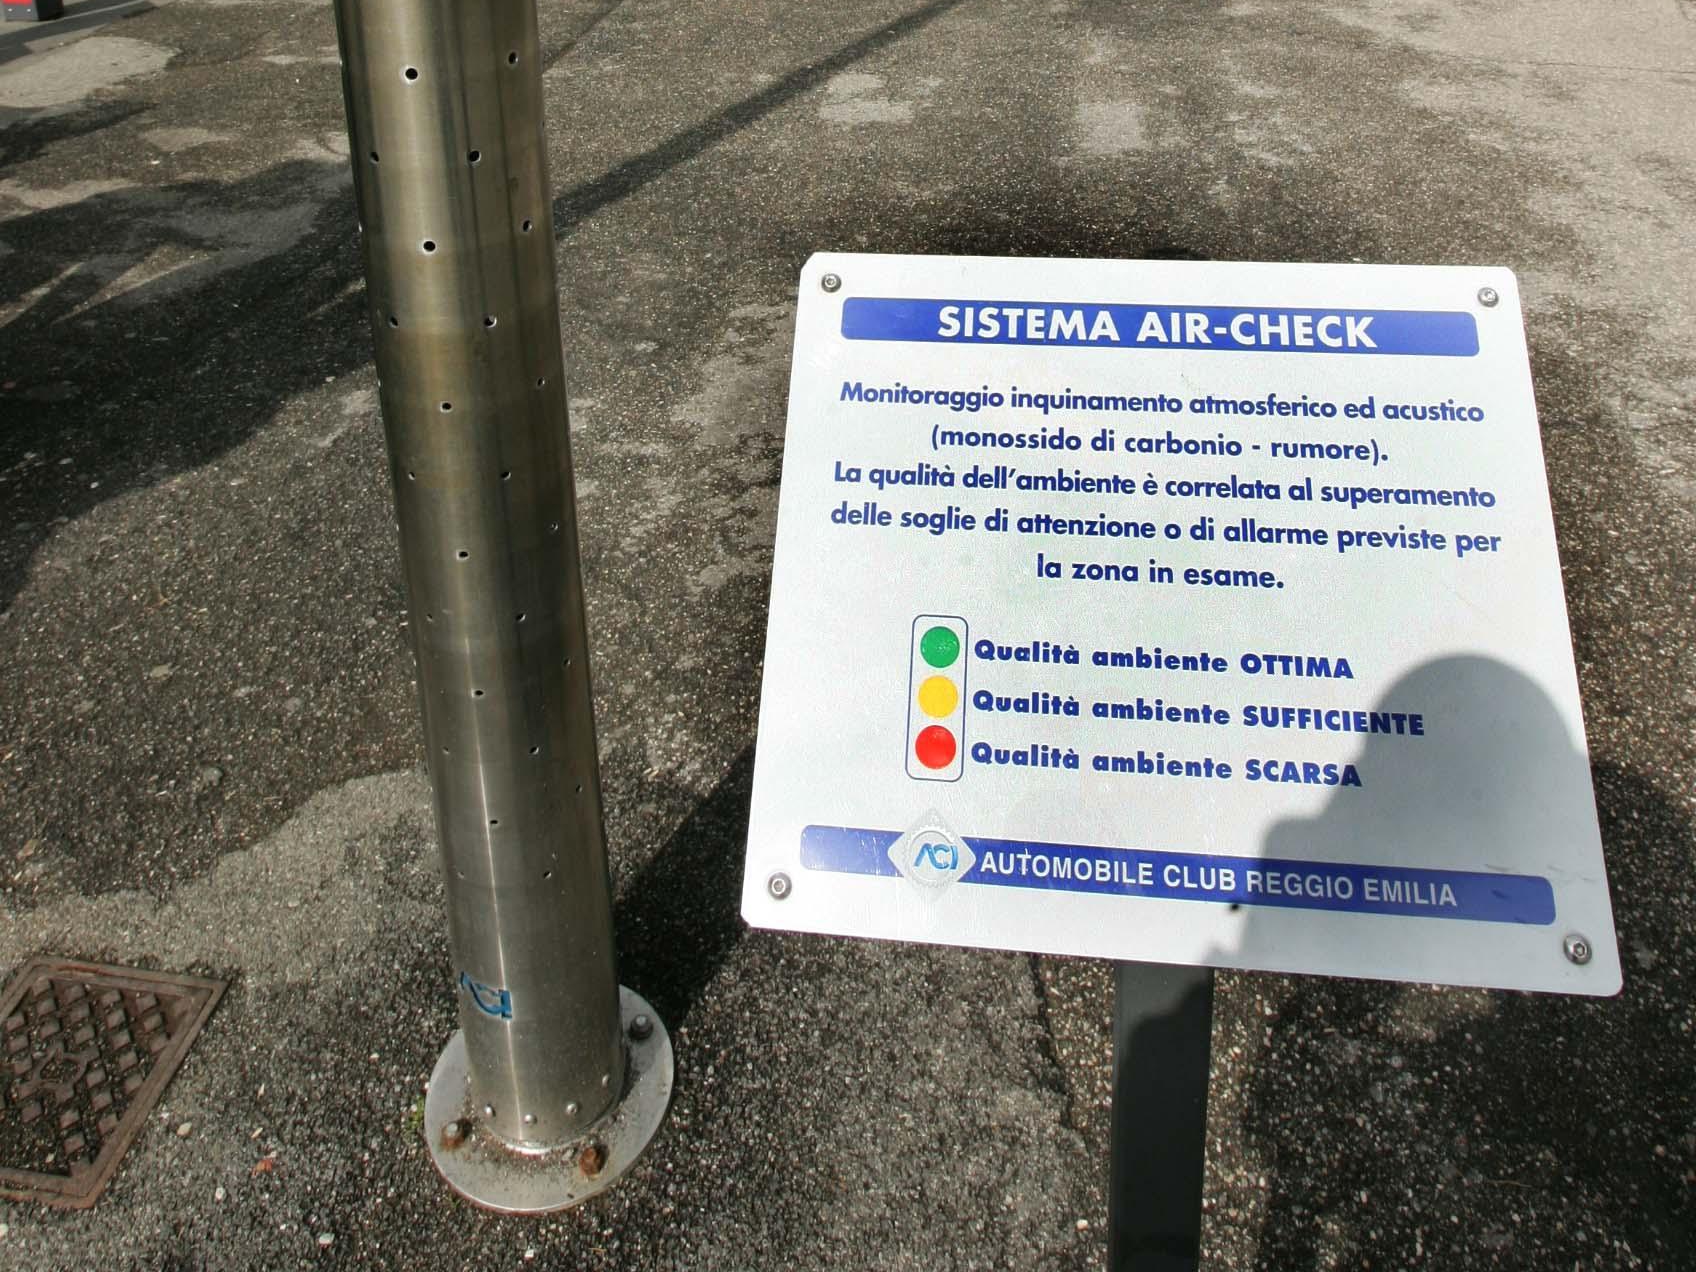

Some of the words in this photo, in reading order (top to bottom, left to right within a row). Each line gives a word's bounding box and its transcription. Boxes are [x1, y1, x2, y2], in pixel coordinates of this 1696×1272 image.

[938, 306, 1120, 340] SISTEMA
[1137, 312, 1377, 347] AIR-CHECK
[840, 382, 1004, 412] Monitoraggio
[1012, 386, 1182, 415] inquinamento
[1190, 393, 1337, 417] atmosferico
[1344, 396, 1375, 418] ed
[1383, 399, 1484, 421] acustico
[932, 425, 1081, 450] (monossido
[1091, 429, 1114, 451] di
[1125, 431, 1242, 456] carbonio
[1271, 439, 1388, 466] rumore).
[835, 461, 861, 482] La
[869, 463, 954, 490] qualità
[963, 465, 1136, 494] dell'ambiente
[1143, 473, 1158, 495] è
[1165, 475, 1280, 499] correlata
[1289, 477, 1312, 500] al
[1321, 486, 1495, 509] superamento
[831, 501, 892, 526] delle
[901, 506, 976, 535] soglie
[985, 508, 1008, 531] di
[1017, 513, 1156, 538] attenzione
[1164, 524, 1181, 539] o
[1190, 517, 1214, 540] di
[1224, 518, 1328, 545] allarme
[1337, 525, 1446, 553] previste
[1456, 535, 1501, 557] per
[1038, 553, 1061, 578] la
[1072, 564, 1138, 581] zona
[1150, 559, 1173, 583] in
[1184, 569, 1284, 588] esame.
[975, 640, 1079, 664] Qualità
[1092, 647, 1228, 672] ambiente
[1241, 654, 1353, 679] OTTIMA
[973, 690, 1079, 716] Qualità
[1092, 698, 1230, 725] ambiente
[1243, 706, 1424, 734] SUFFICIENTE
[972, 742, 1079, 769] Qualità
[1093, 751, 1232, 778] ambiente
[1246, 759, 1361, 786] SCARSA
[914, 842, 958, 870] ACI
[981, 849, 1153, 884] AUTOMOBILE
[1164, 865, 1235, 890] CLUB
[1246, 870, 1352, 899] REGGIO
[1364, 879, 1457, 907] EMILIA
